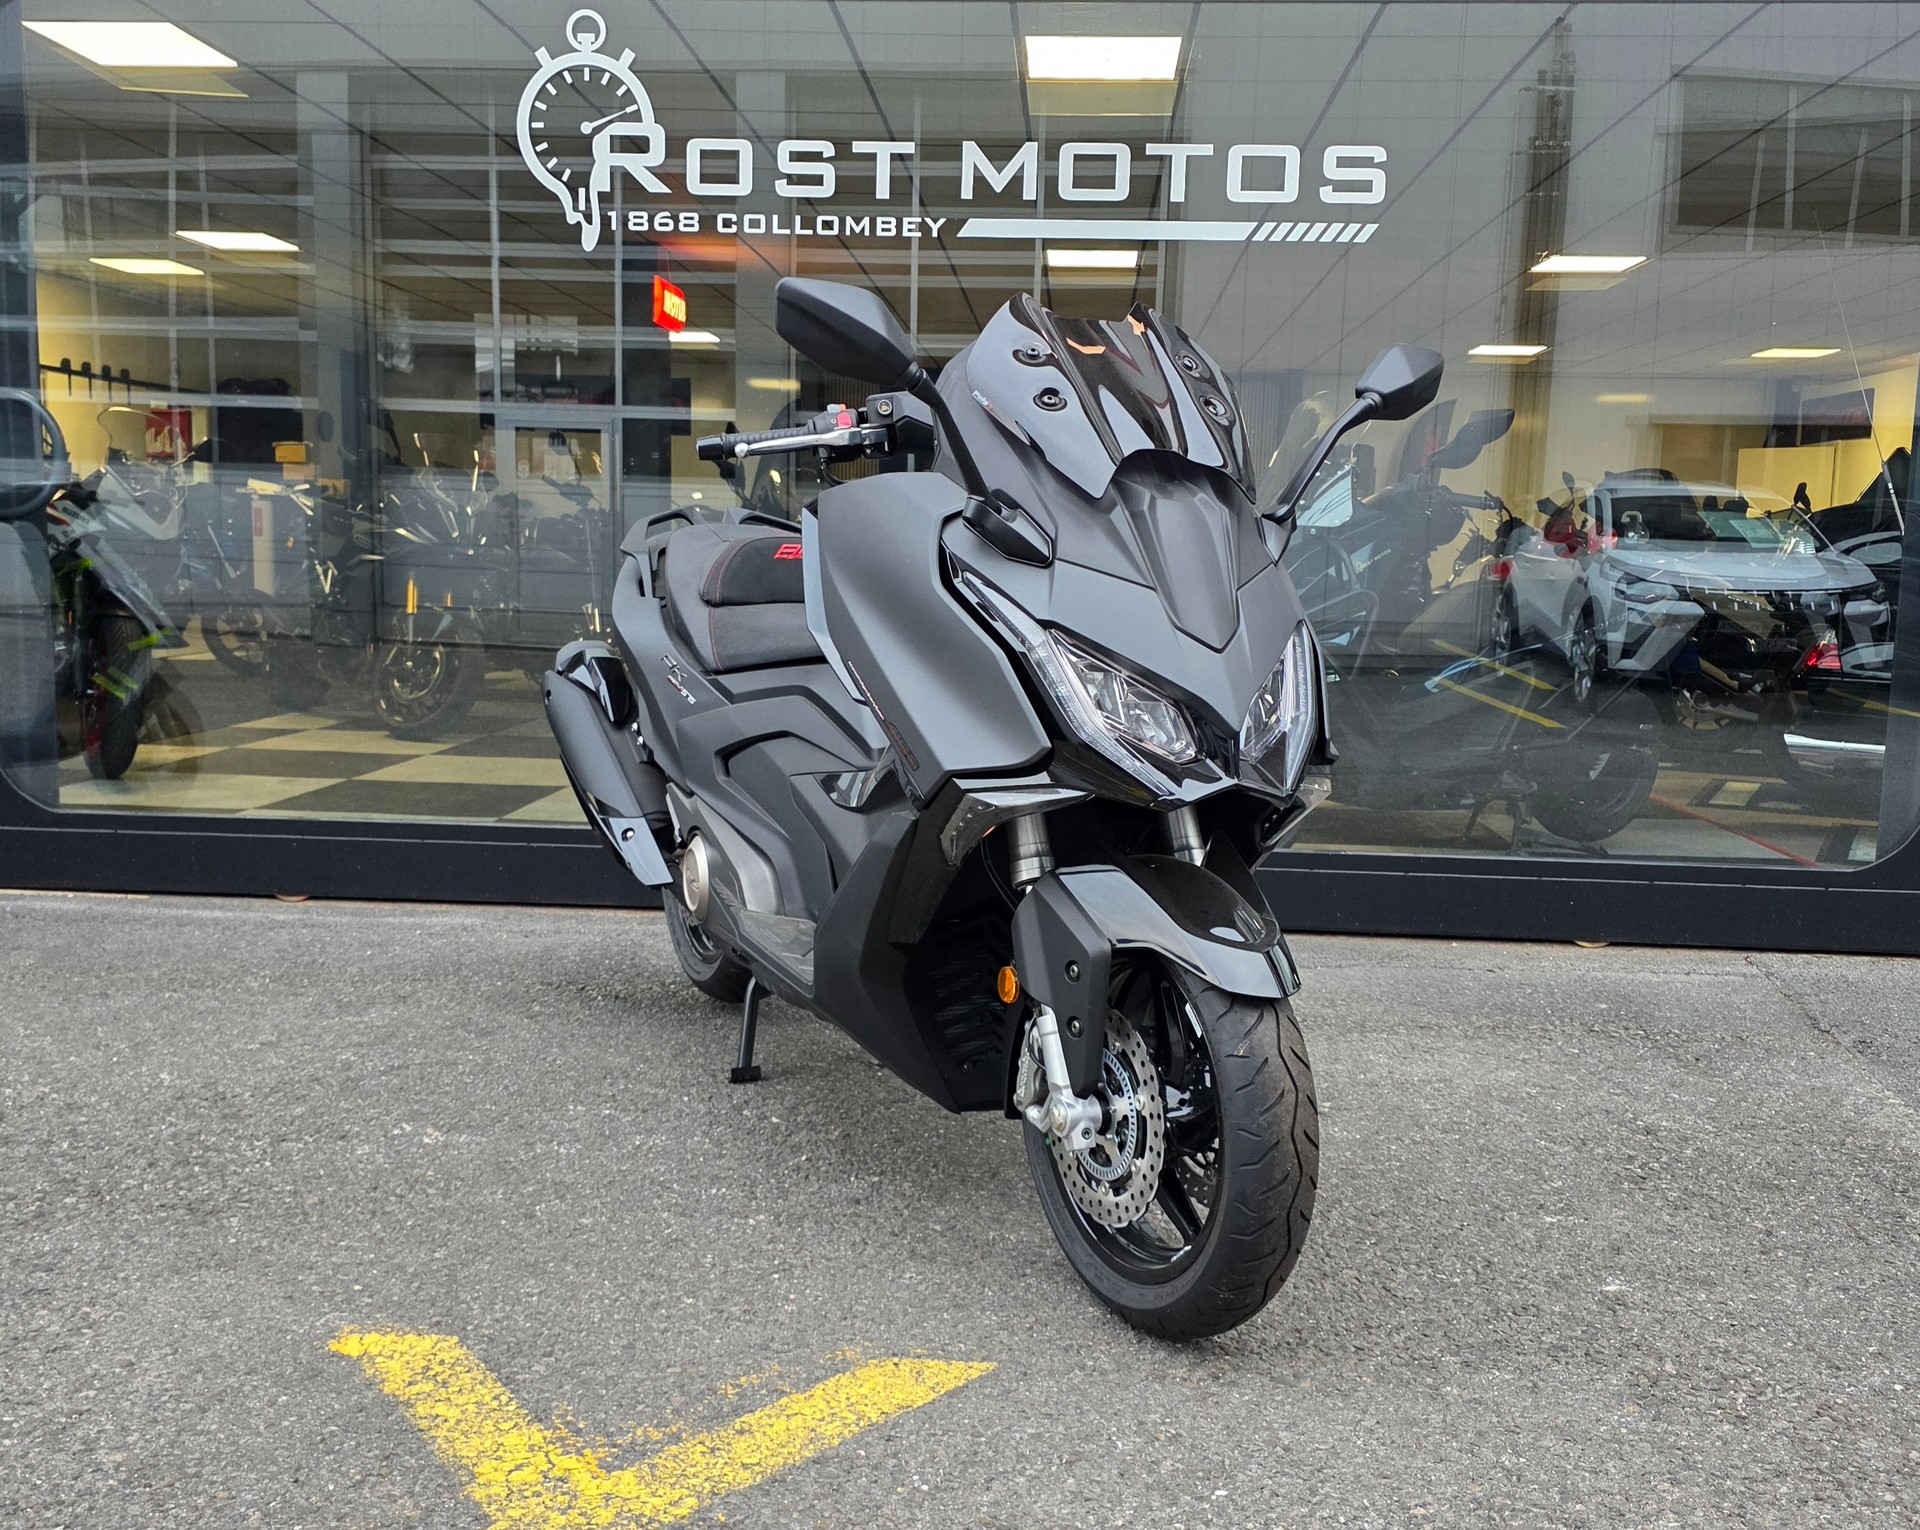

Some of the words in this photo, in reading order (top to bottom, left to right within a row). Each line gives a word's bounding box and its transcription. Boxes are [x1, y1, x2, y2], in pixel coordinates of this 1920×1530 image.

[593, 122, 915, 200] ROST
[960, 140, 1388, 204] MOTOS
[607, 211, 700, 232] 1868
[717, 214, 947, 238] COLLOMBEY
